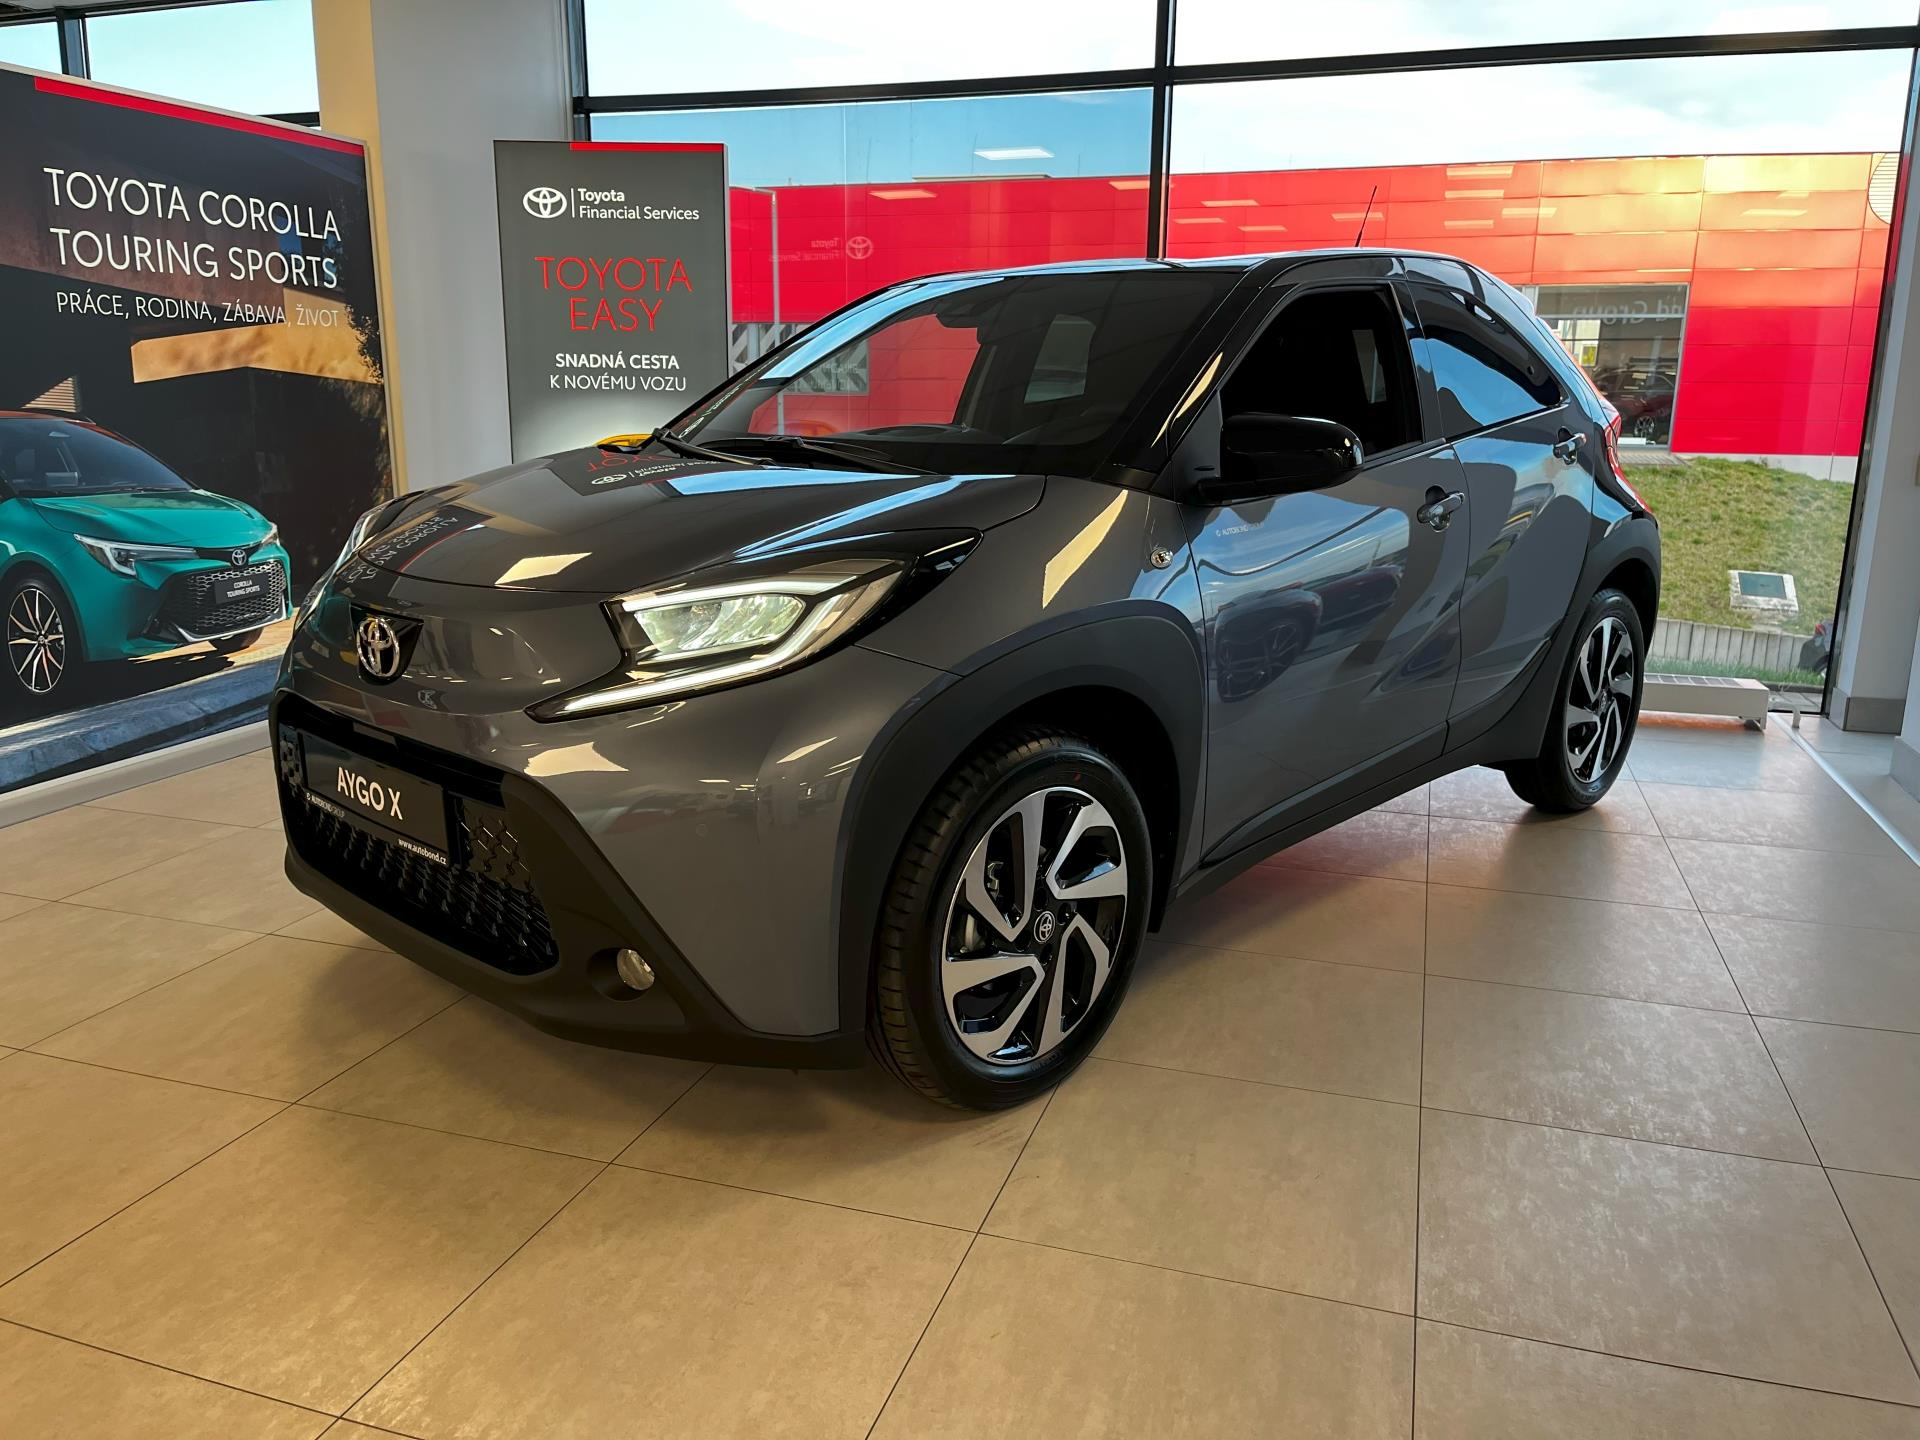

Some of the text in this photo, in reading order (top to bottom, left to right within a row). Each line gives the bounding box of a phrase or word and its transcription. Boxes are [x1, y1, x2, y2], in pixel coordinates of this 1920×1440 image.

[43, 167, 342, 242] TOYOTA COROLLA
[577, 188, 625, 204] Toyota
[579, 206, 700, 220] Financial Services
[49, 227, 338, 289] TOURING SPORTS
[535, 256, 694, 292] TOYOTA
[56, 288, 338, 328] PRÁCE, RODINA, ZÁBAVA, ŽIVOT
[569, 297, 663, 331] EASY
[555, 351, 680, 369] SNADNÁ CESTA
[550, 373, 686, 391] K NOVÉMU VOZU
[338, 766, 403, 820] AYGO X
[398, 838, 447, 865] www.autobond.cz
